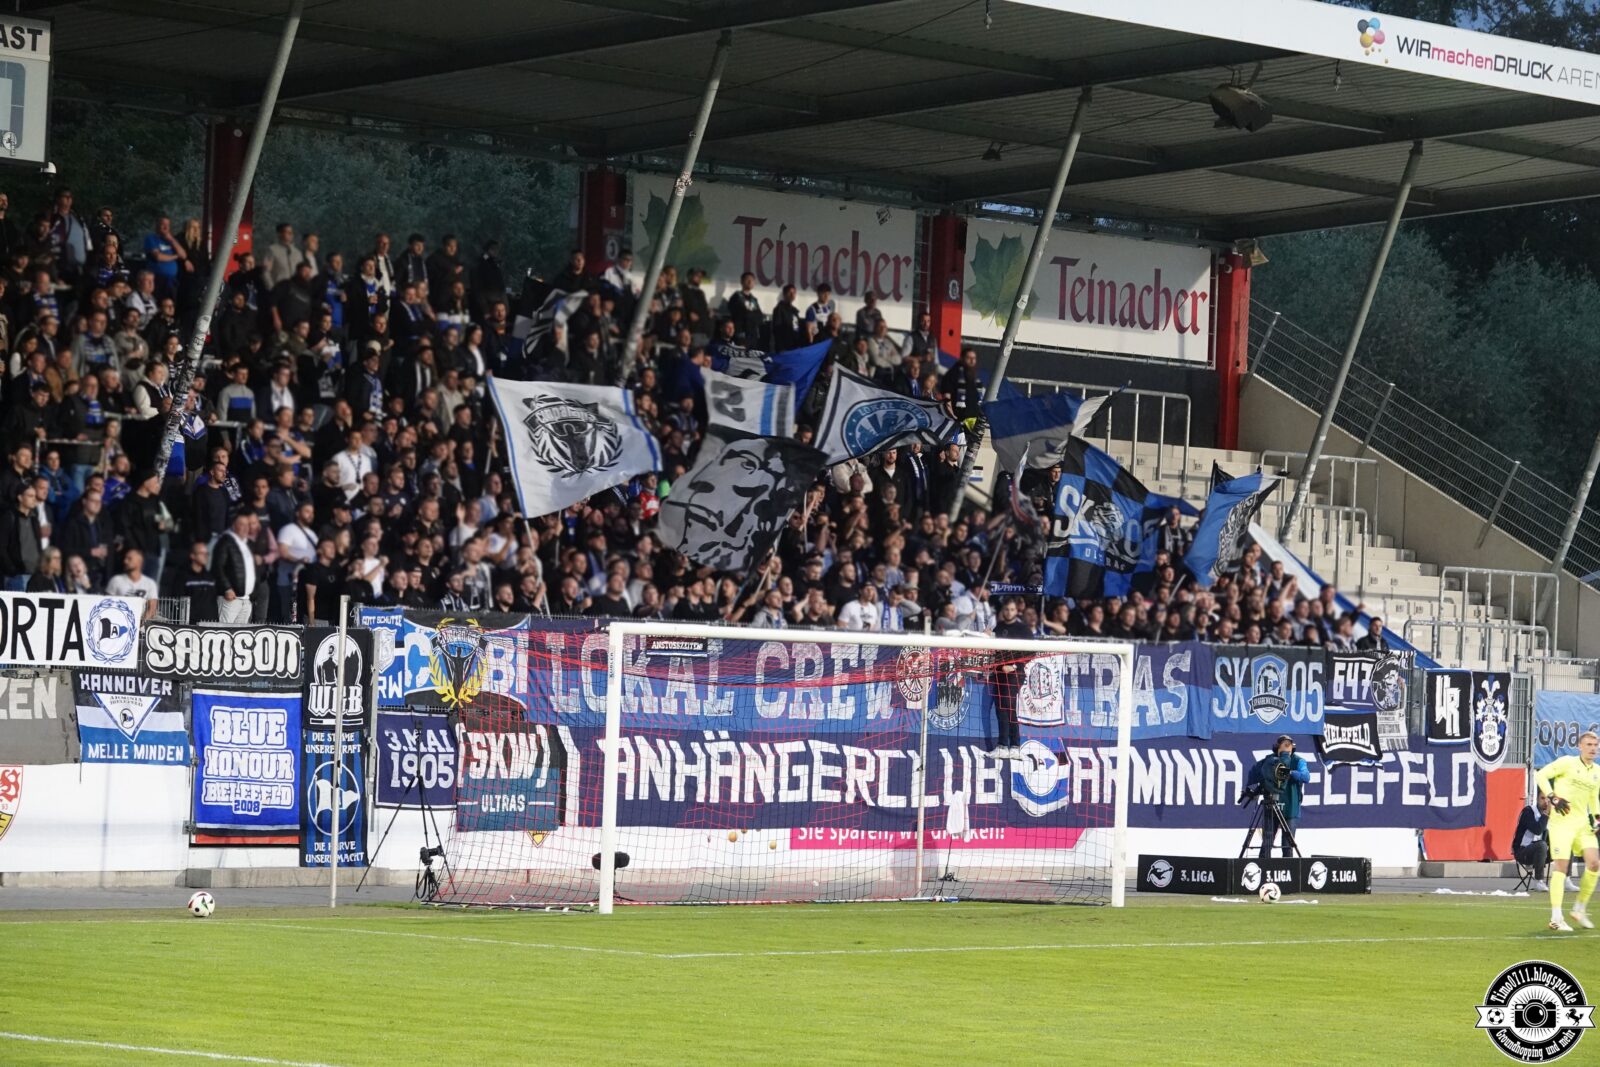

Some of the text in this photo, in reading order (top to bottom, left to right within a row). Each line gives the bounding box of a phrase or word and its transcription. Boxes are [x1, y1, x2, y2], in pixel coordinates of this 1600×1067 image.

[1396, 35, 1554, 82] WIRmachenDRUCK
[732, 215, 912, 302] Teinacher
[1050, 256, 1208, 335] Teinacher
[1053, 485, 1097, 538] SK
[147, 625, 302, 679] SAMSON
[79, 673, 173, 696] HANNOVER
[546, 631, 735, 717] LOKAL
[755, 641, 894, 720] CREW
[1213, 656, 1325, 725] SK 05
[1333, 661, 1374, 700] 647
[211, 707, 287, 747] BLUE
[1324, 722, 1371, 748] BIELEFELD
[88, 742, 185, 762] MELLE MINDEN
[204, 747, 294, 780] HONOUR
[341, 744, 362, 754] RAFT
[390, 751, 455, 789] 1905
[1253, 750, 1475, 808] ELEFELD
[203, 781, 294, 807] BIELEFELD
[234, 800, 260, 813] 2008
[481, 794, 526, 813] ULTRAS
[1180, 869, 1215, 883] 3. LIGA
[1265, 869, 1292, 883] 3. LIGA
[1331, 869, 1357, 883] 3. LIGA
